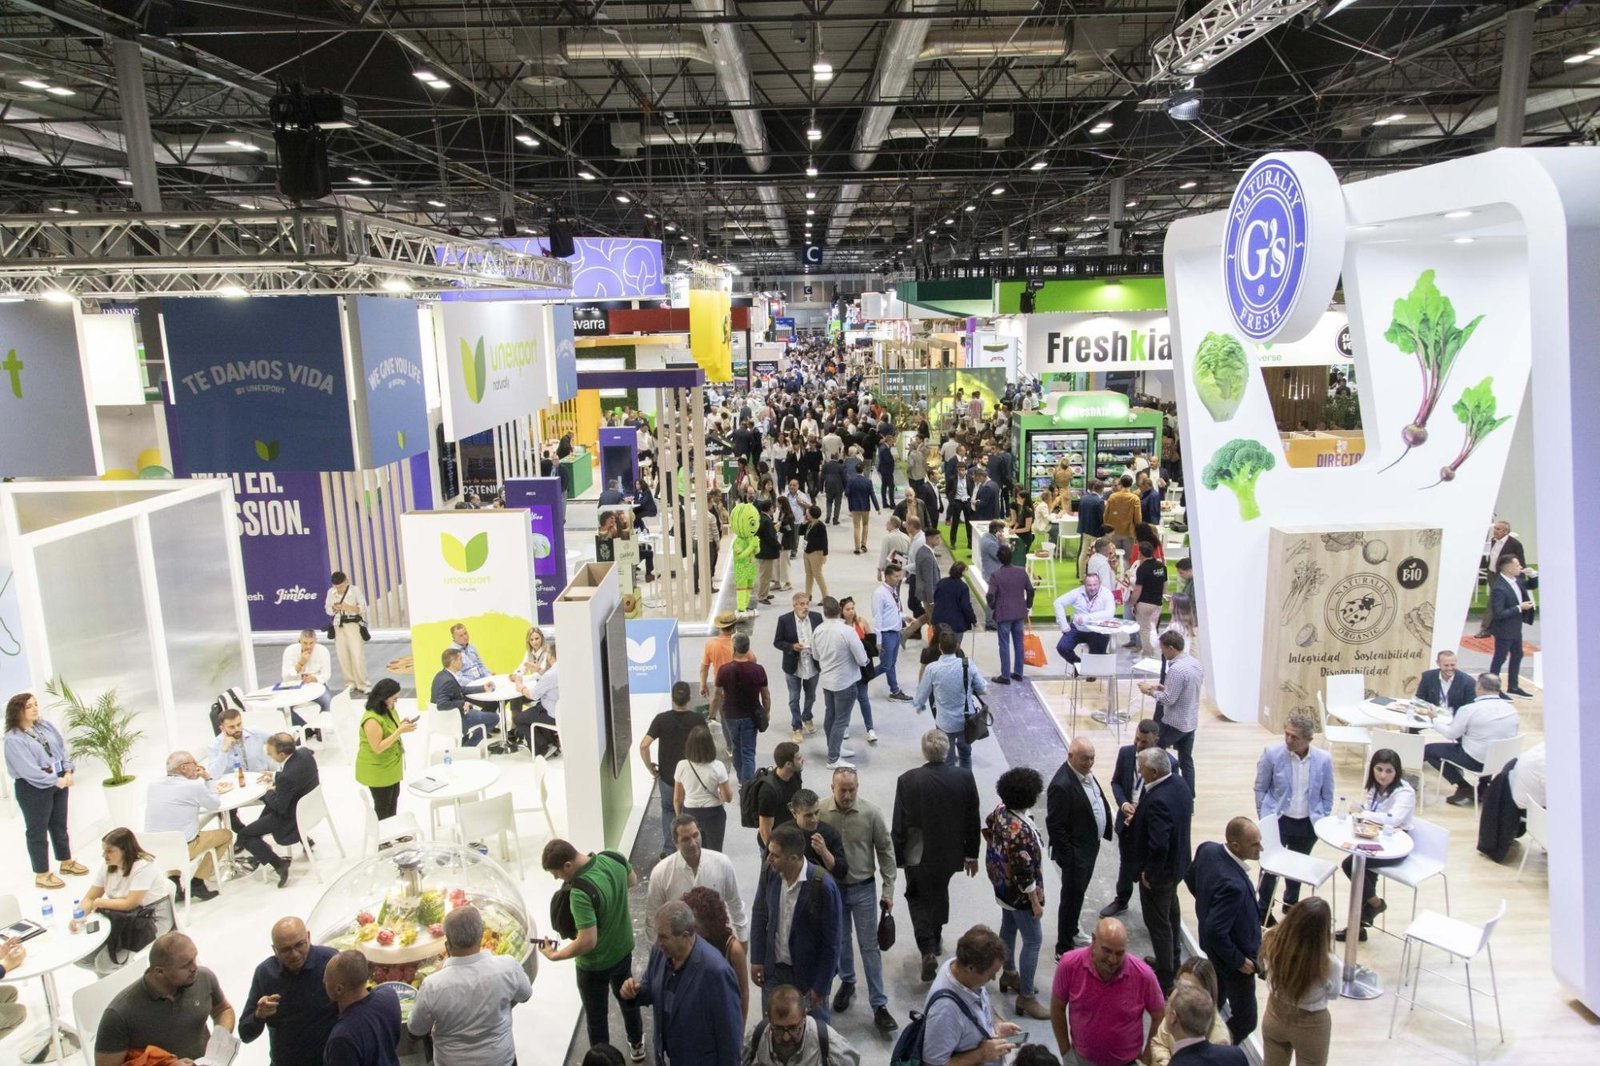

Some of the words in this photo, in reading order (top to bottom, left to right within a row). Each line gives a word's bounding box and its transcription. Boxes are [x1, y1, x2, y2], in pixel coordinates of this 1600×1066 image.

[1235, 170, 1300, 223] NATURALLY
[806, 247, 819, 261] C
[1240, 218, 1286, 281] G's
[1240, 304, 1281, 331] FRESH
[489, 336, 538, 377] unexport
[1047, 328, 1172, 364] Freshkia
[181, 370, 211, 395] TE
[210, 359, 284, 386] DAMOS
[288, 362, 334, 395] VIDA
[245, 384, 286, 395] UNEXPORT
[274, 587, 317, 605] Jimbee
[1335, 577, 1390, 596] NATURALLY
[1338, 627, 1381, 640] ORGANIC
[1288, 651, 1341, 664] Integridad
[1354, 649, 1424, 661] Sostenibilidad
